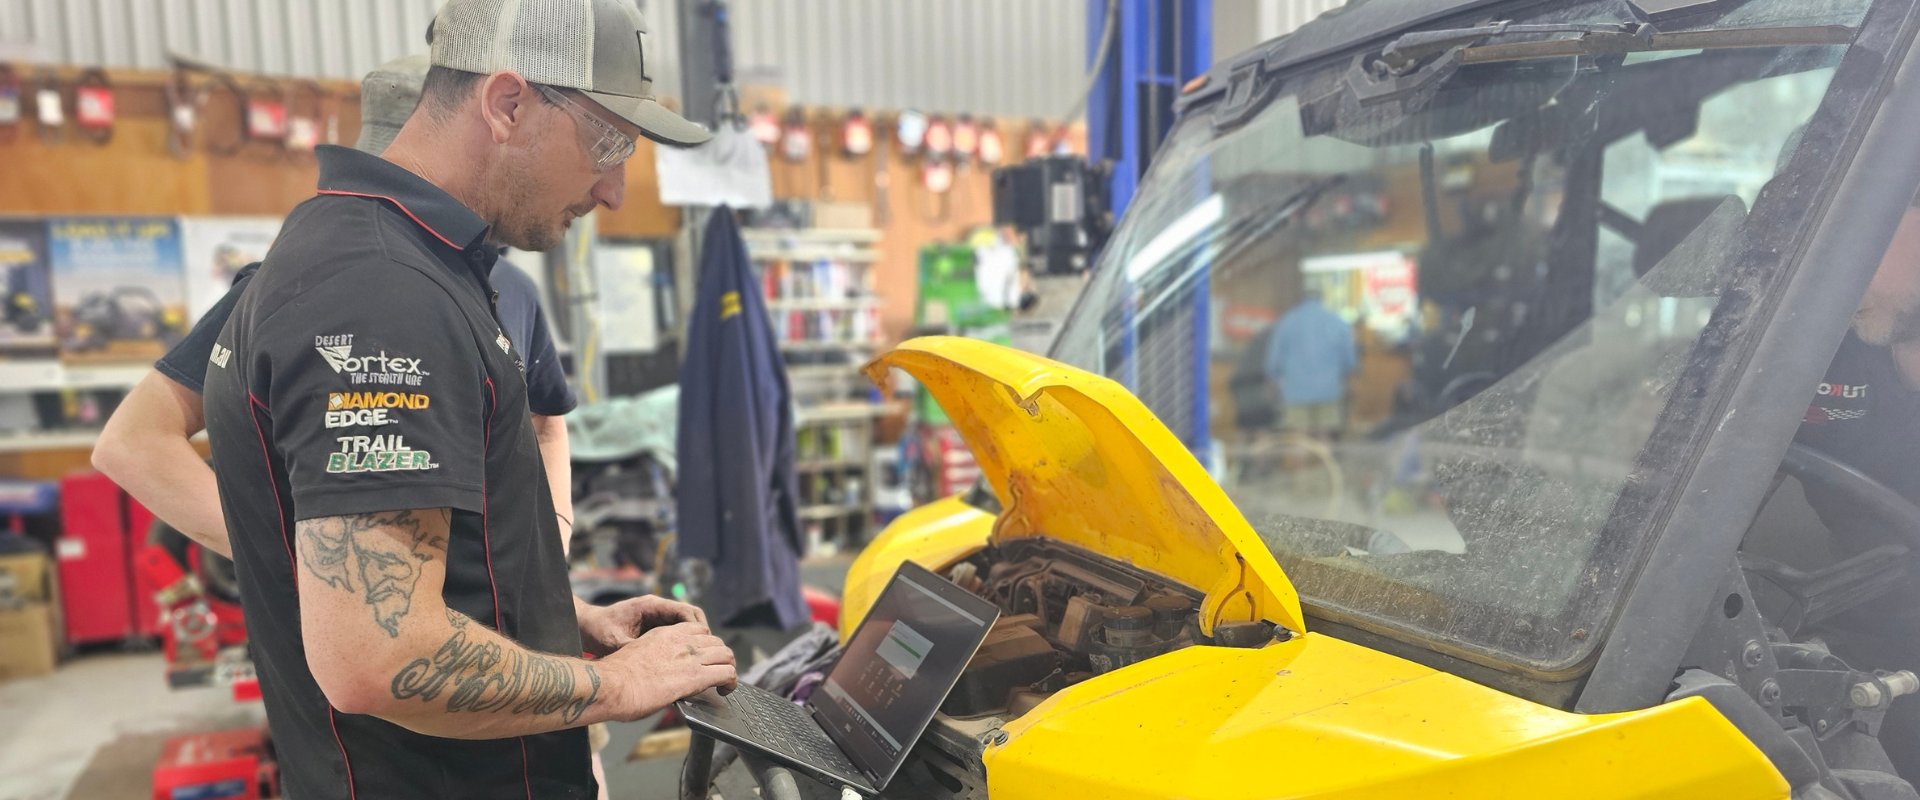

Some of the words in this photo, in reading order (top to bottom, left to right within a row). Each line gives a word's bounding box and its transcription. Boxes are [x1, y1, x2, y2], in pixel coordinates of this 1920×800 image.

[315, 334, 354, 347] DESERT
[350, 372, 367, 385] THE
[368, 371, 403, 386] STEALTH
[328, 392, 430, 410] DIAMOND
[337, 434, 411, 453] TRAIL
